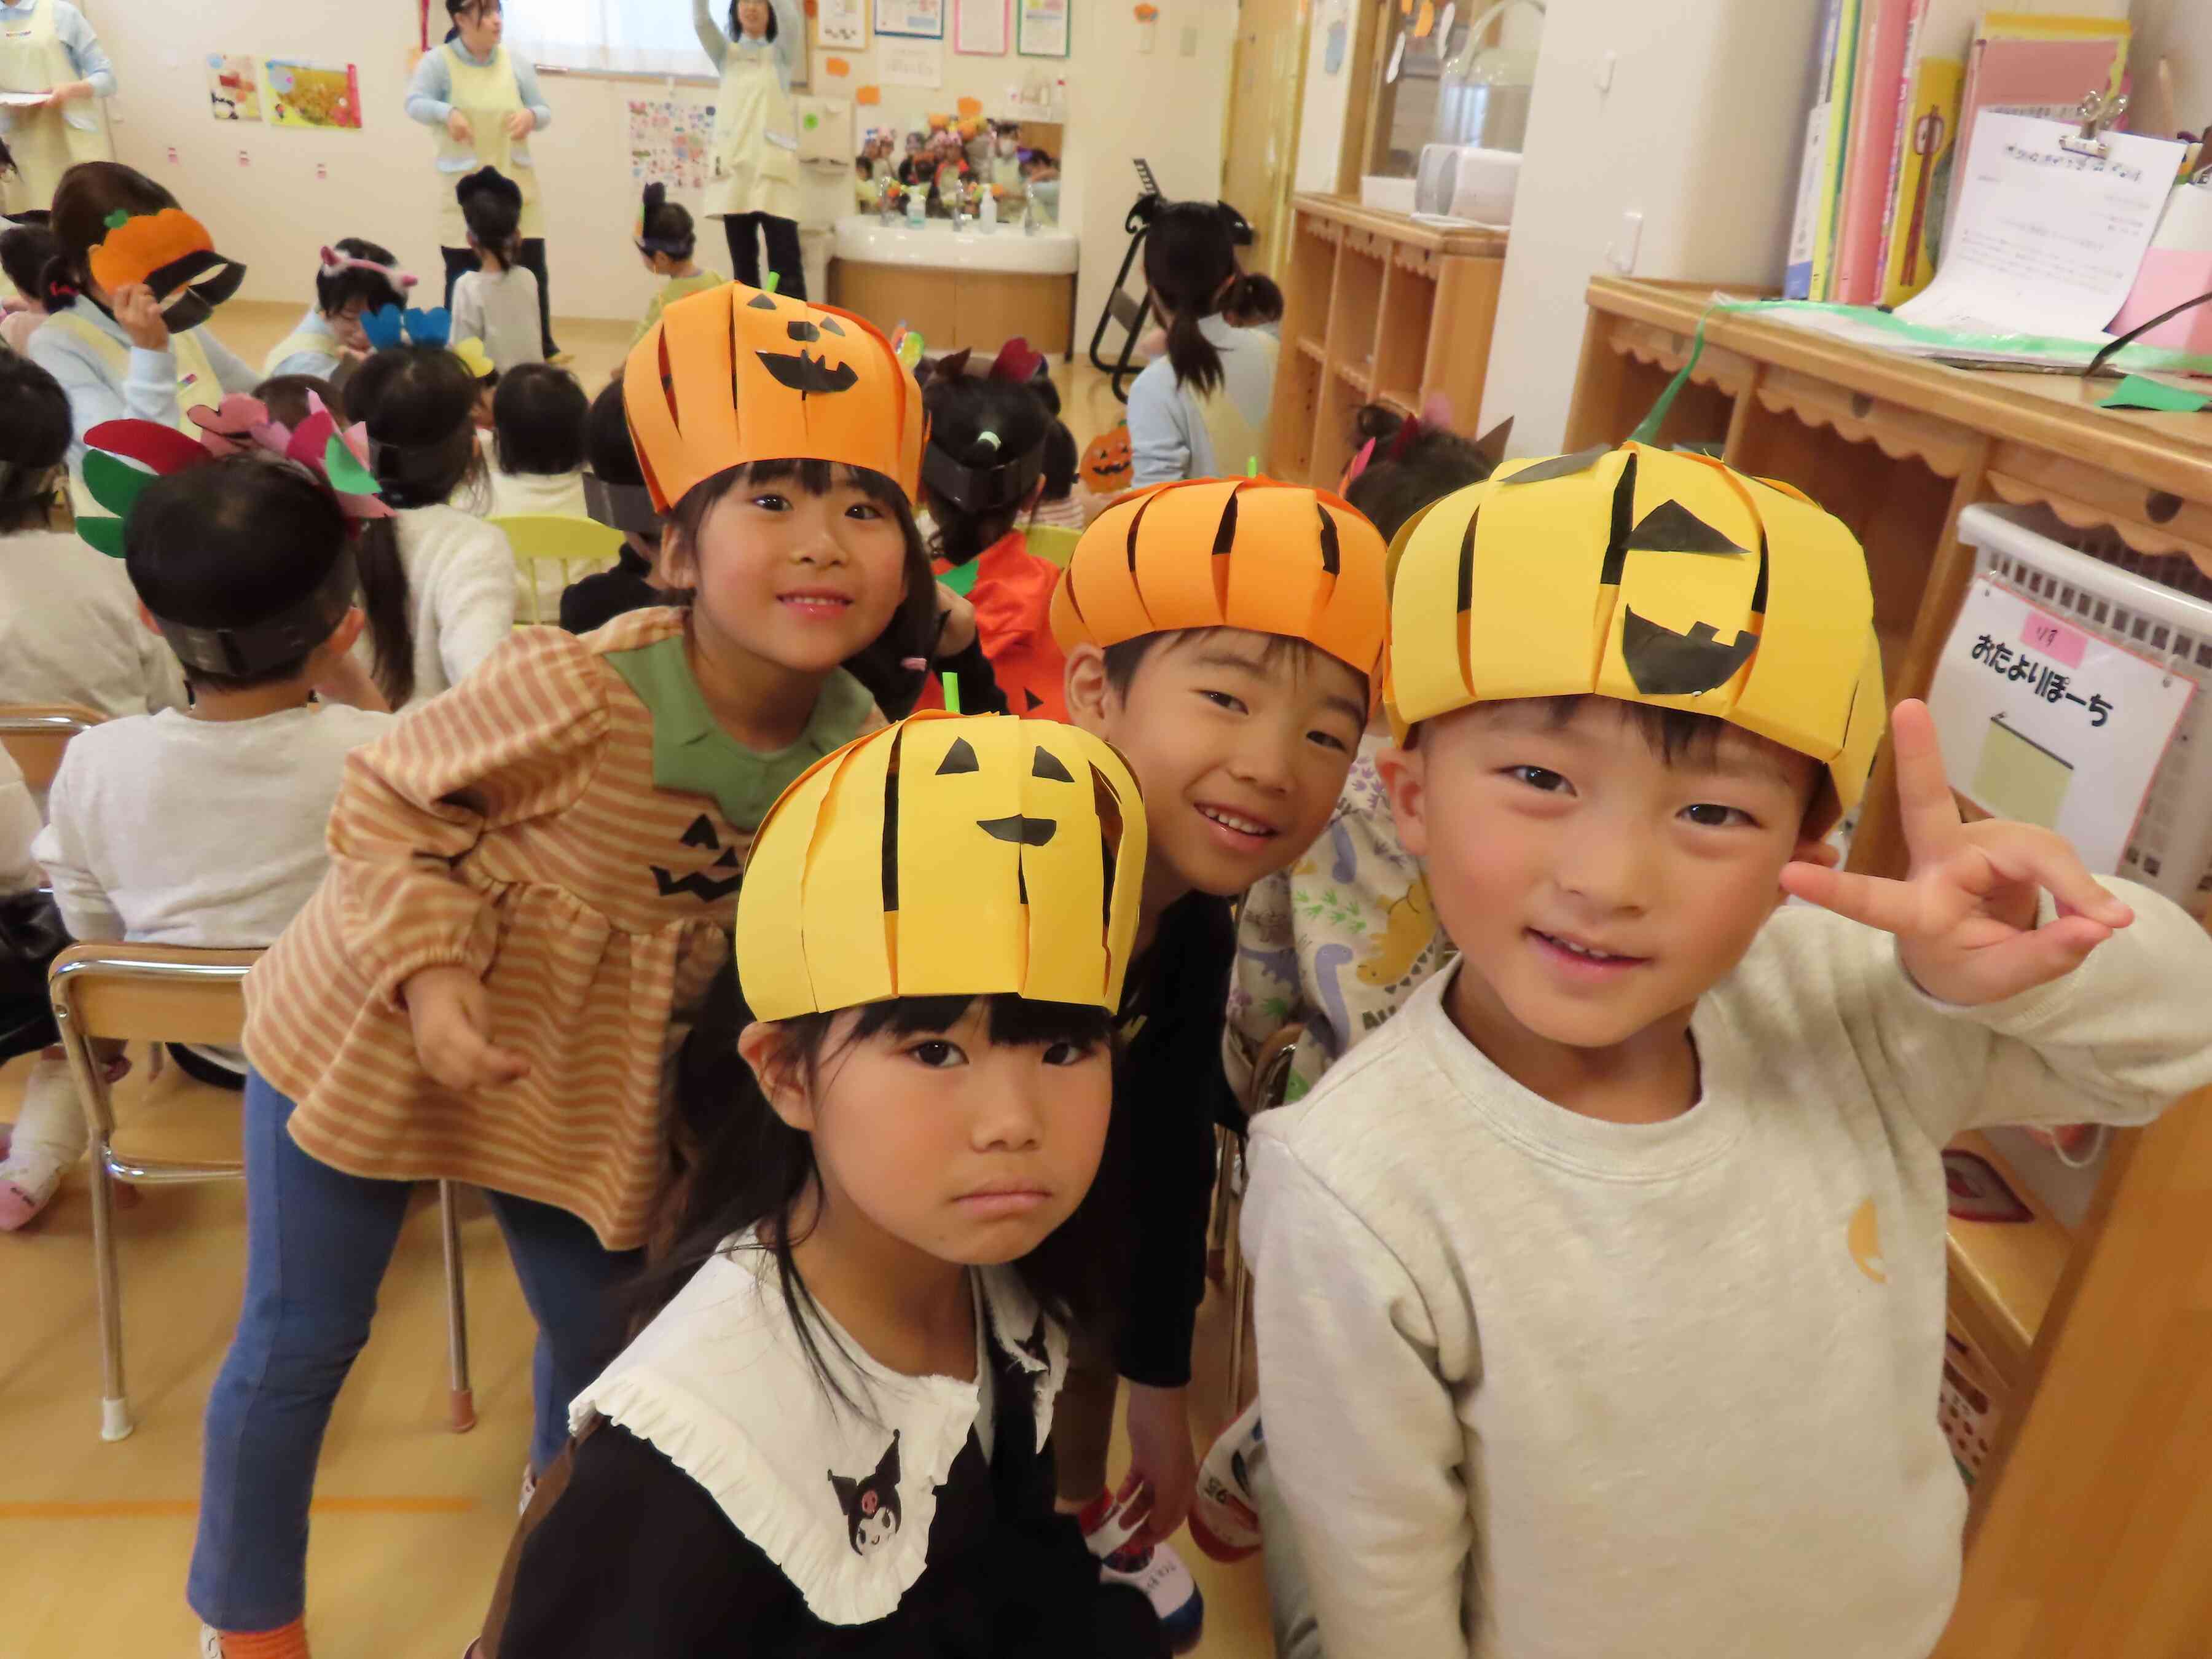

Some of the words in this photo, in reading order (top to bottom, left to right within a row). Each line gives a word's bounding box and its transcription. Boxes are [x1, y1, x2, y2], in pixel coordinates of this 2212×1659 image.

[1972, 634, 2113, 727] おたよりぽーち
